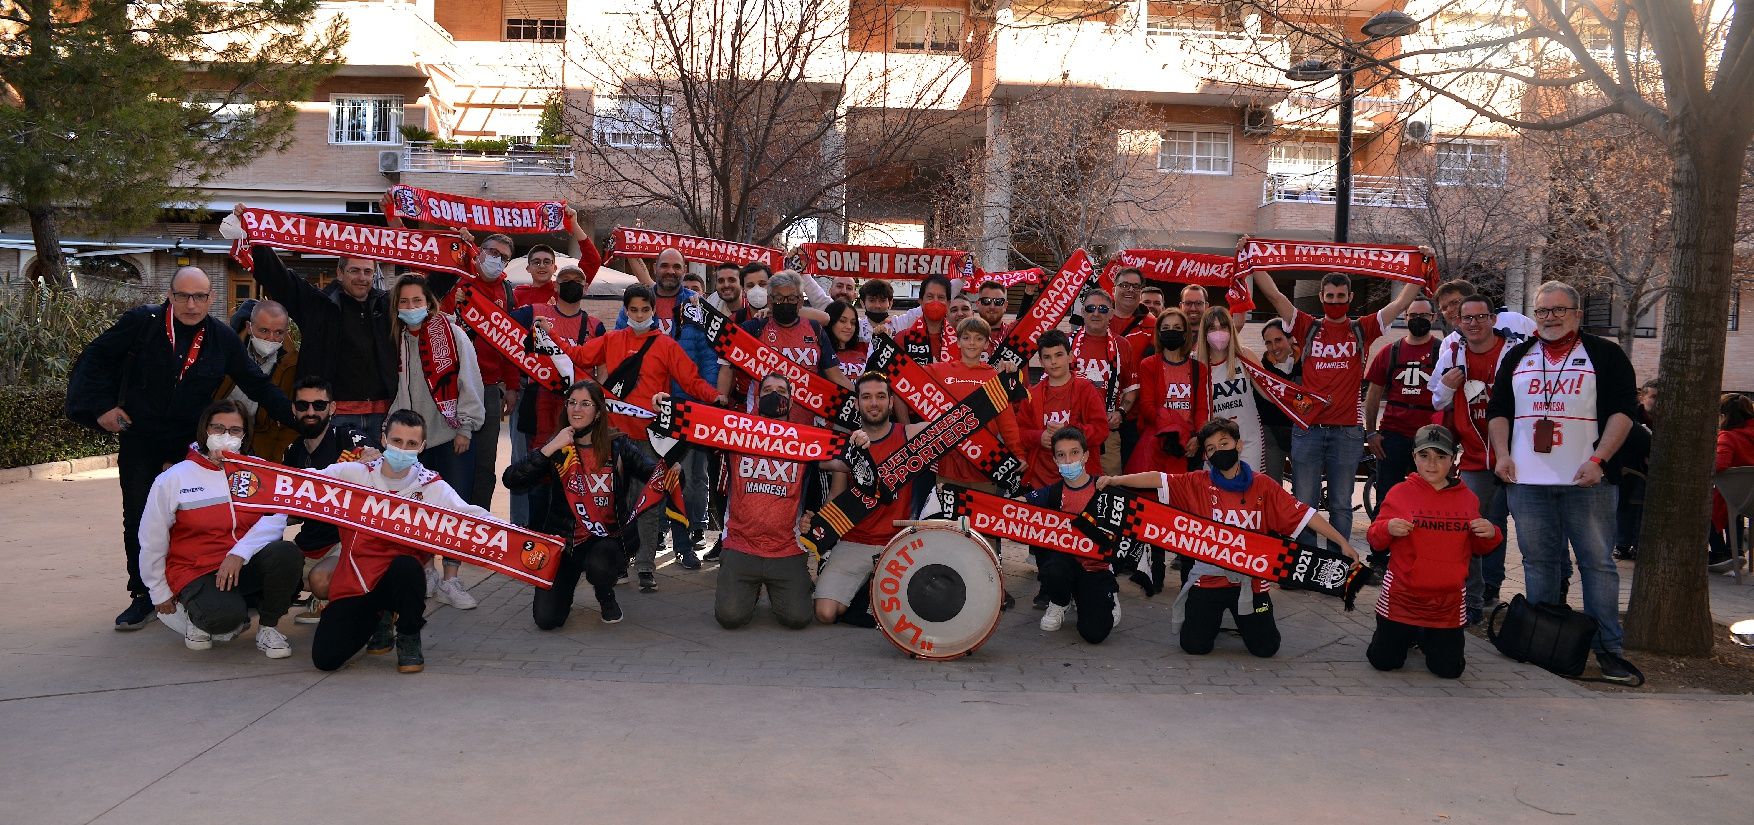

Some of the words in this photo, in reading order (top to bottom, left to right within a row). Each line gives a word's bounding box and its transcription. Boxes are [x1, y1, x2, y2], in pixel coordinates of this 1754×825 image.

[427, 197, 491, 226] SOM-HI
[492, 206, 537, 228] RESA!
[243, 211, 305, 236] BAXI
[315, 221, 440, 255] MANRESA
[248, 230, 276, 241] OPA
[284, 235, 307, 245] DEL
[316, 240, 338, 249] REI
[345, 243, 403, 258] GRANADA
[410, 252, 439, 263] 2022
[624, 230, 672, 247] BAXI
[678, 237, 772, 266] MANRESA
[1238, 242, 1288, 262] BAXI
[1294, 244, 1411, 266] MANRESA
[815, 250, 889, 274] SOM-HI
[895, 254, 951, 276] RESA!
[1175, 257, 1234, 279] MANRE
[1268, 256, 1288, 264] DEL
[1295, 255, 1314, 264] REI
[1320, 257, 1374, 268] GRANADA
[1379, 263, 1409, 273] 2022
[1028, 258, 1093, 344] D'ANIMACIÓ
[1032, 269, 1075, 319] GRADA
[490, 311, 529, 349] GRA
[706, 314, 725, 343] 1931
[465, 307, 553, 381] D'ANIMACIÓ
[781, 347, 818, 367] AXI
[877, 344, 895, 369] 1931
[907, 343, 930, 354] 1931
[1311, 340, 1357, 359] BAXI
[756, 346, 811, 388] GRADA
[1076, 358, 1113, 382] BAX
[1315, 360, 1349, 370] MANRESA
[922, 382, 954, 412] GRA
[1166, 383, 1192, 399] AX
[1213, 377, 1248, 401] AXI
[1527, 373, 1585, 396] BAXI!
[660, 400, 672, 430] 1931
[723, 414, 799, 440] GRADA
[907, 403, 973, 453] MANRESA
[693, 424, 823, 458] D'ANIMACIÓ
[738, 455, 799, 484] BAXI
[992, 456, 1019, 482] 2021
[240, 471, 252, 499] BAXI
[745, 482, 788, 498] MANRESA
[273, 473, 353, 511] BAXI
[360, 495, 509, 553] MANRESA
[1002, 503, 1073, 533] GRADA
[1109, 495, 1125, 527] 1931
[1412, 519, 1470, 532] MANRESA
[273, 496, 313, 509] COPA
[323, 506, 350, 519] DEL
[359, 515, 385, 528] REI
[393, 523, 462, 549] GRANADA
[470, 544, 504, 561] 2022
[1173, 515, 1248, 551] GRADA
[1116, 536, 1132, 559] 20
[1143, 522, 1270, 574] D'ANIMACIÓ
[1292, 549, 1314, 583] 2021
